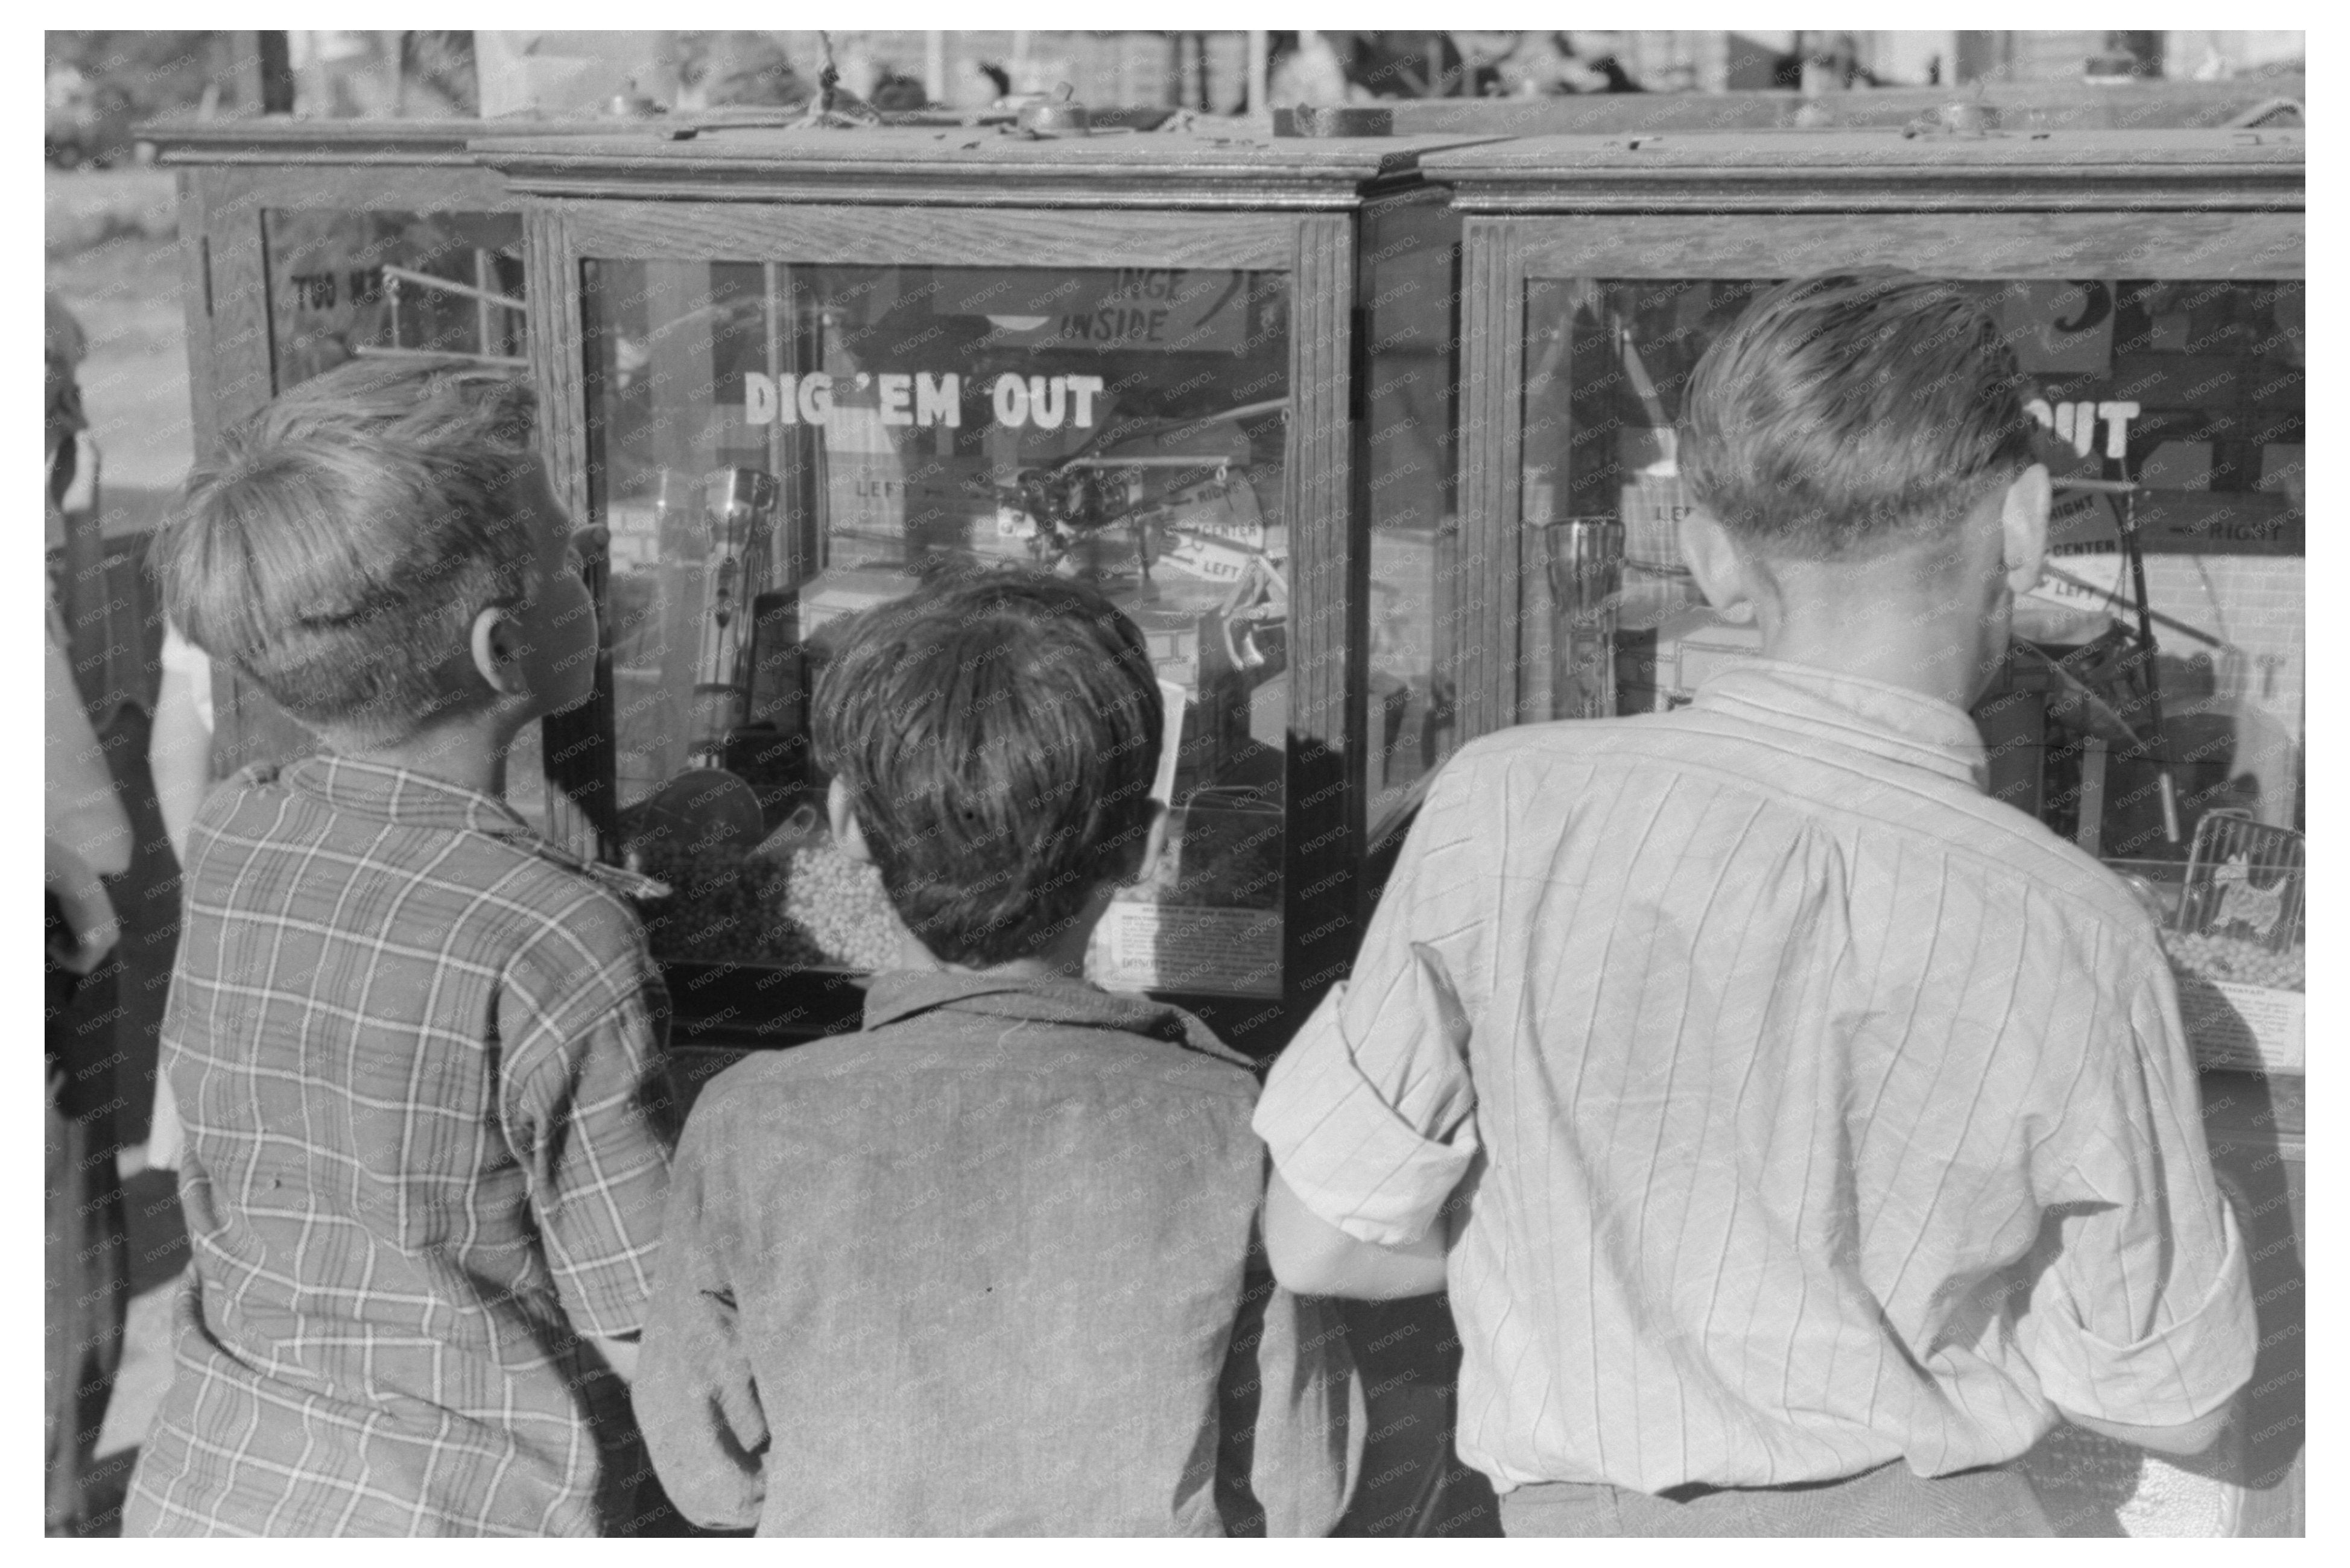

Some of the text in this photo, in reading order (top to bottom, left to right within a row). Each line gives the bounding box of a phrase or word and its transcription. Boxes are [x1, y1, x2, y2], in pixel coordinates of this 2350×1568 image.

[1060, 308, 1169, 343] INSIDE
[744, 372, 1104, 429] DIG 'EM OUT
[2210, 522, 2282, 541] RIGHT
[2053, 539, 2116, 557] CENTER
[1203, 561, 1240, 578] LEFT
